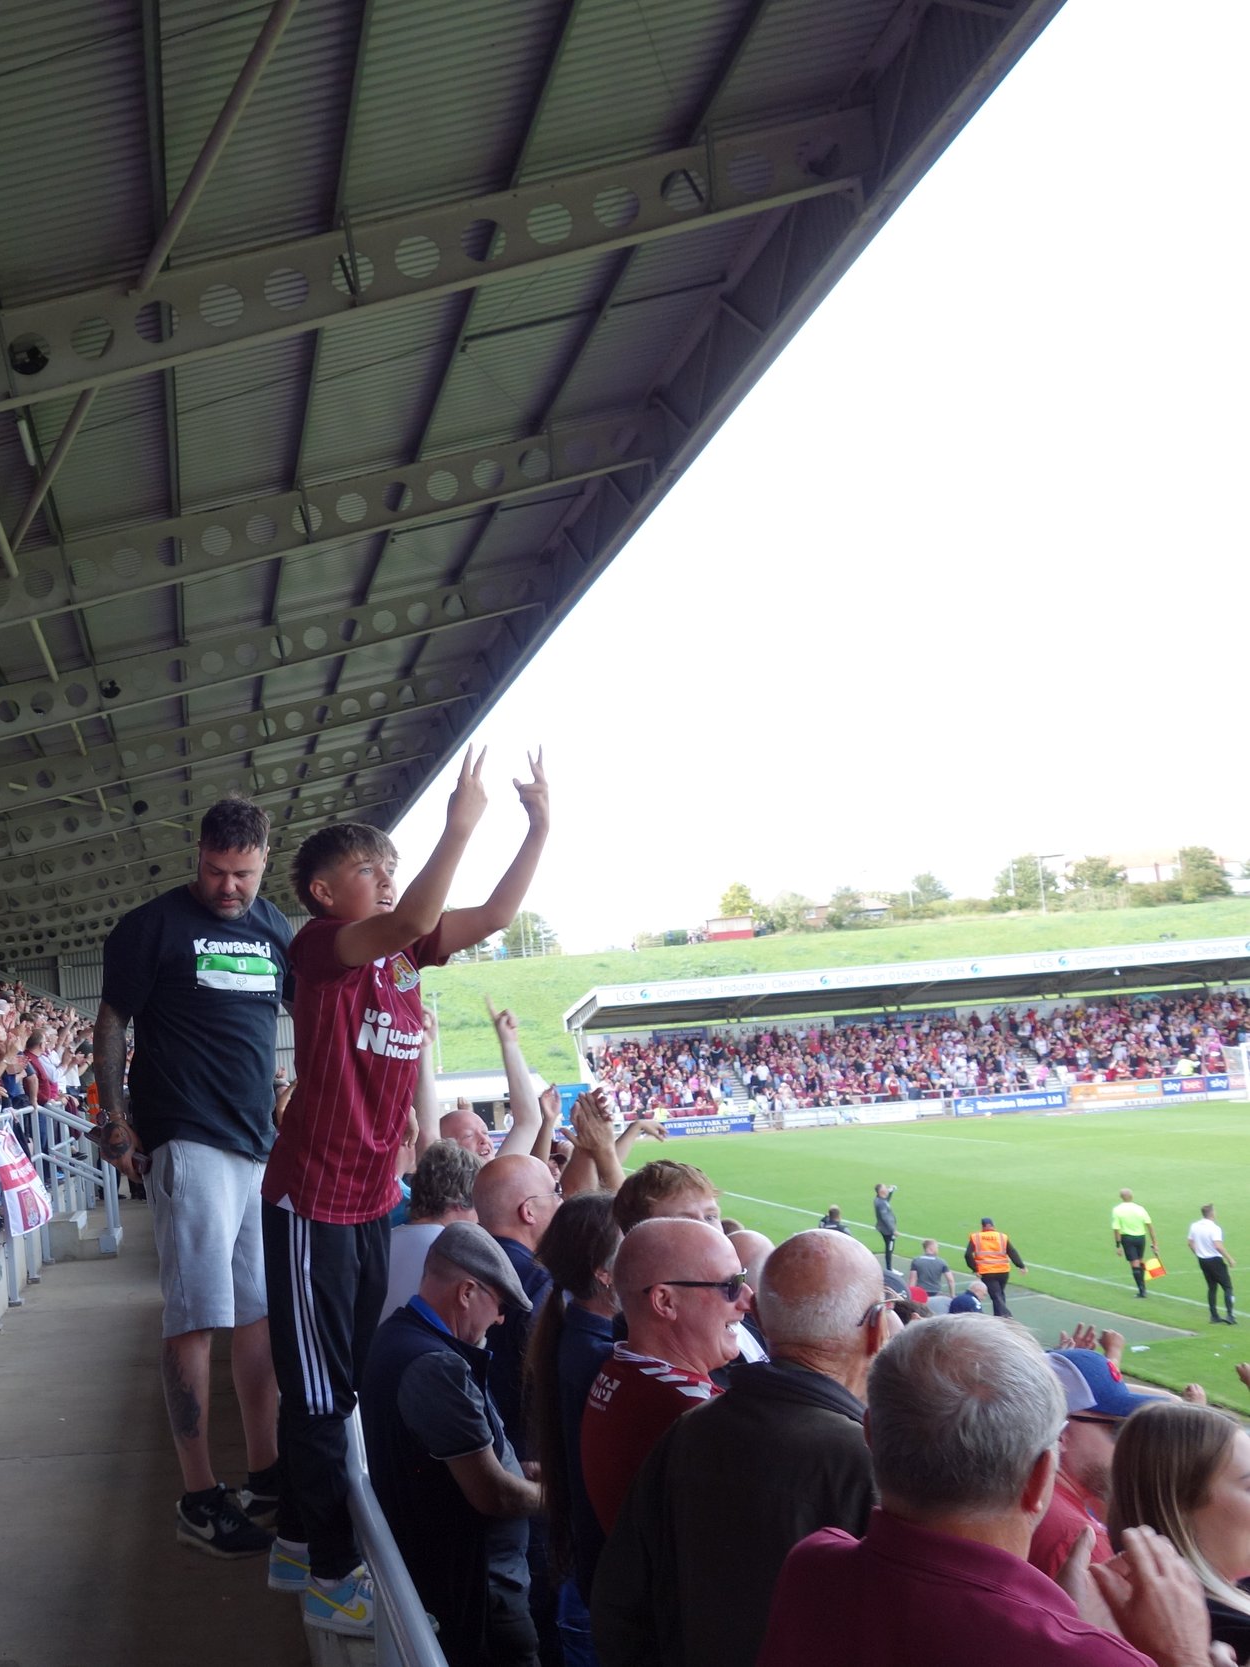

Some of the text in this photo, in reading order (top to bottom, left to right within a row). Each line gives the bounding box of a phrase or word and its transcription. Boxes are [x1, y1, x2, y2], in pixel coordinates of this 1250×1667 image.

[193, 938, 270, 958] Kawasaki
[616, 990, 635, 1001] LCS
[657, 985, 714, 999] Commercial
[720, 982, 766, 993] Industrial
[772, 978, 815, 989] Cleaning
[1164, 1081, 1182, 1092] sky
[1183, 1080, 1201, 1090] bet
[1210, 1077, 1228, 1088] sky
[665, 1117, 749, 1129] OVERSTONE PARK SCHOOL
